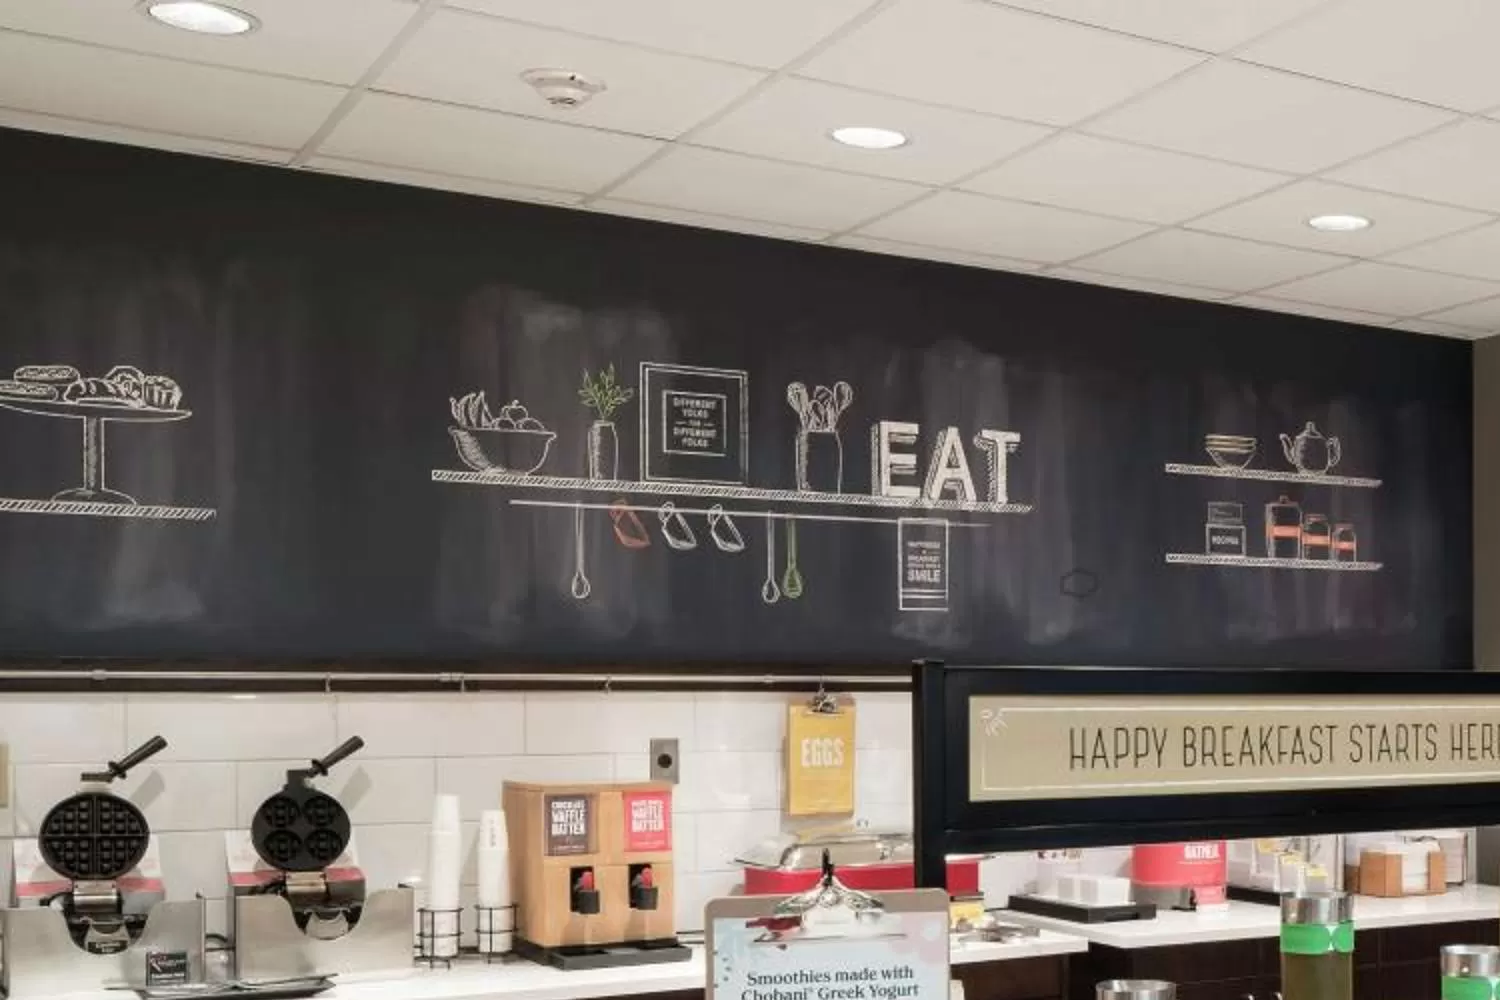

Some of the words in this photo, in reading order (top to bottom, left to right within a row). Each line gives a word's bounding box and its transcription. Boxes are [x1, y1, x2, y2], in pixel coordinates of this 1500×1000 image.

[871, 421, 1020, 504] EAT
[907, 568, 941, 583] SMILE
[801, 737, 845, 767] EGGS
[1069, 726, 1168, 771] HAPPY
[1183, 725, 1338, 769] BREAKFAST
[1348, 723, 1438, 764] STARTS
[552, 809, 586, 823] WAFFLE
[551, 822, 586, 836] BATTER
[747, 969, 831, 986] Smoothies
[835, 967, 877, 982] made
[881, 964, 913, 979] with
[817, 984, 865, 1000] Greek
[869, 983, 919, 1000] Yogurt
